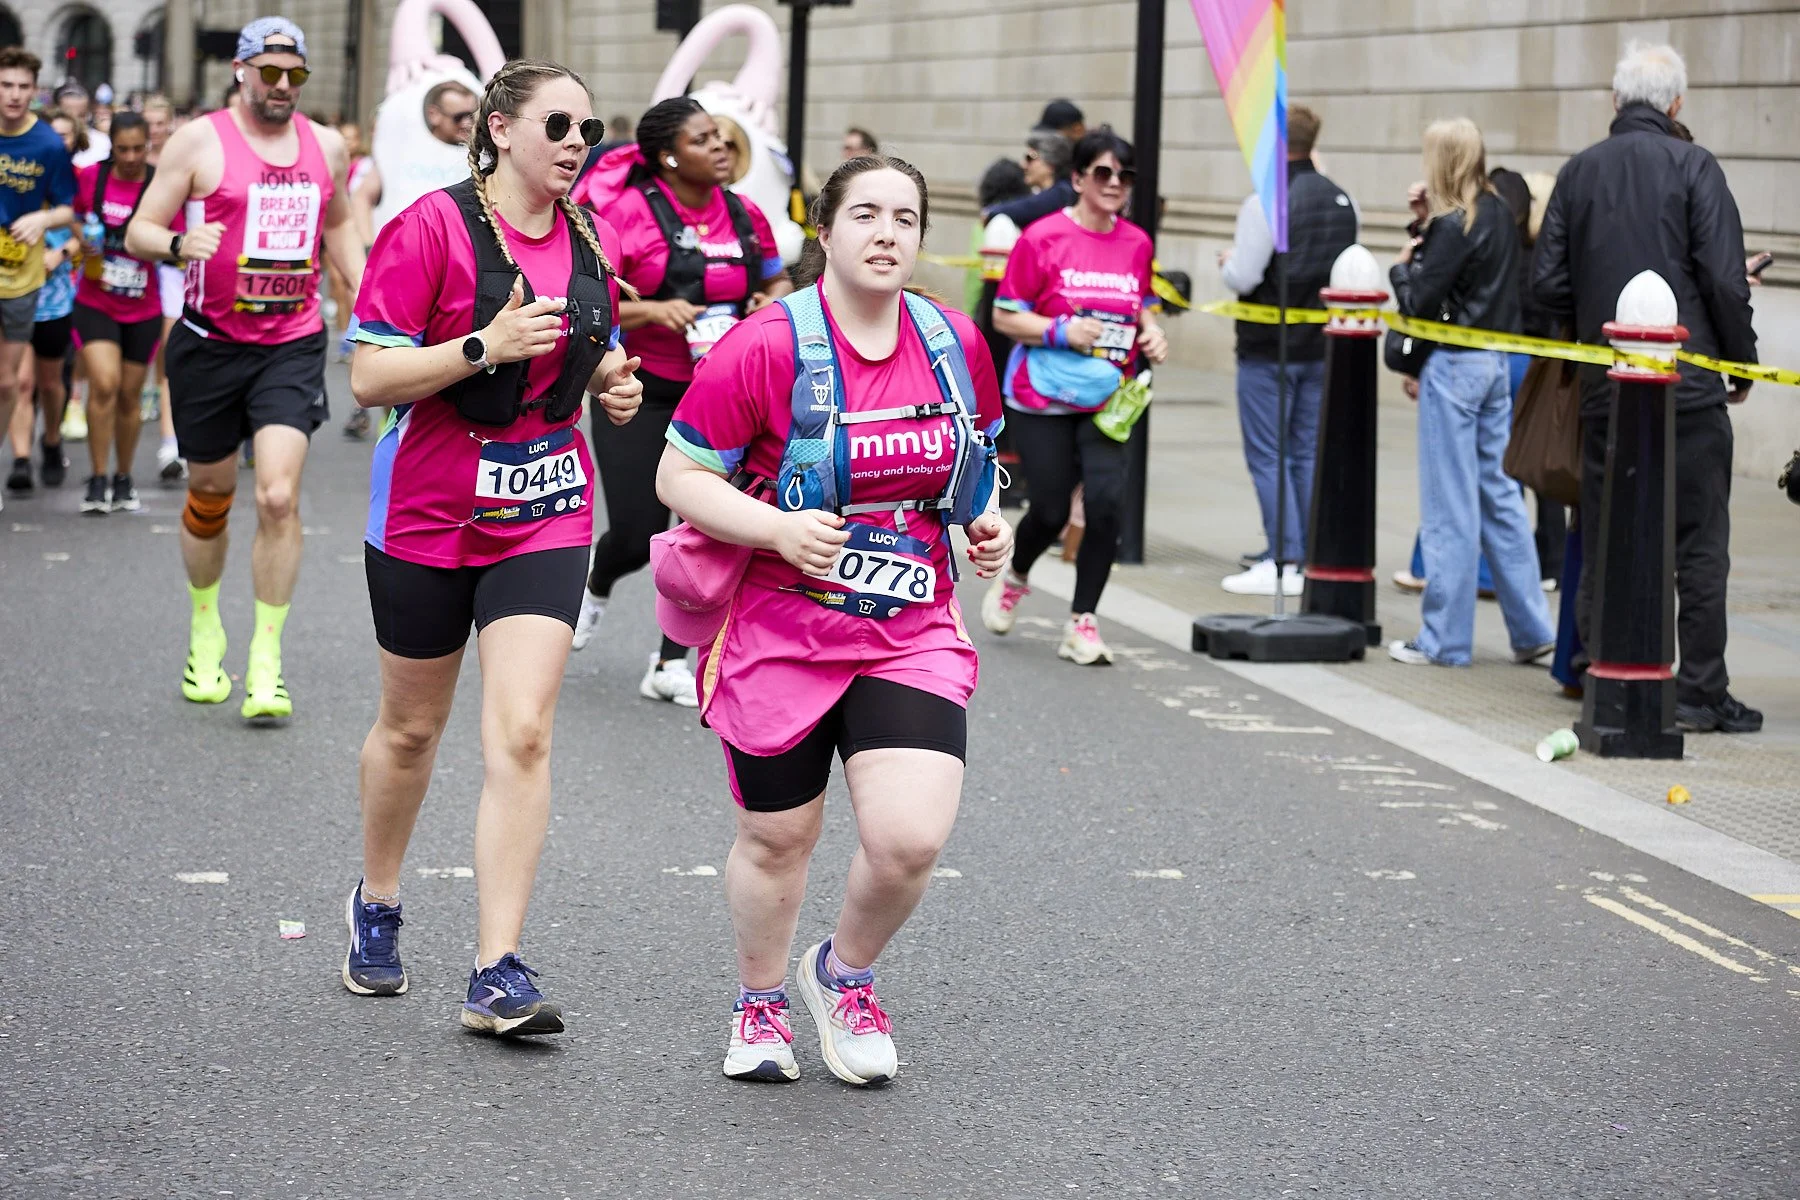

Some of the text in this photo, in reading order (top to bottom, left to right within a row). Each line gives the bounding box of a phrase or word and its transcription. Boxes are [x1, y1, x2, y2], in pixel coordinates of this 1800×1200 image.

[257, 172, 312, 190] JON B
[260, 197, 311, 211] BREAST
[259, 213, 309, 228] CANCER
[244, 275, 307, 296] 17601
[1060, 268, 1139, 293] Tommy's
[528, 440, 549, 454] LUCY
[488, 455, 577, 495] 10449
[883, 465, 904, 476] and
[906, 464, 933, 475] baby
[868, 531, 899, 547] LUCY
[830, 552, 929, 599] 0778
